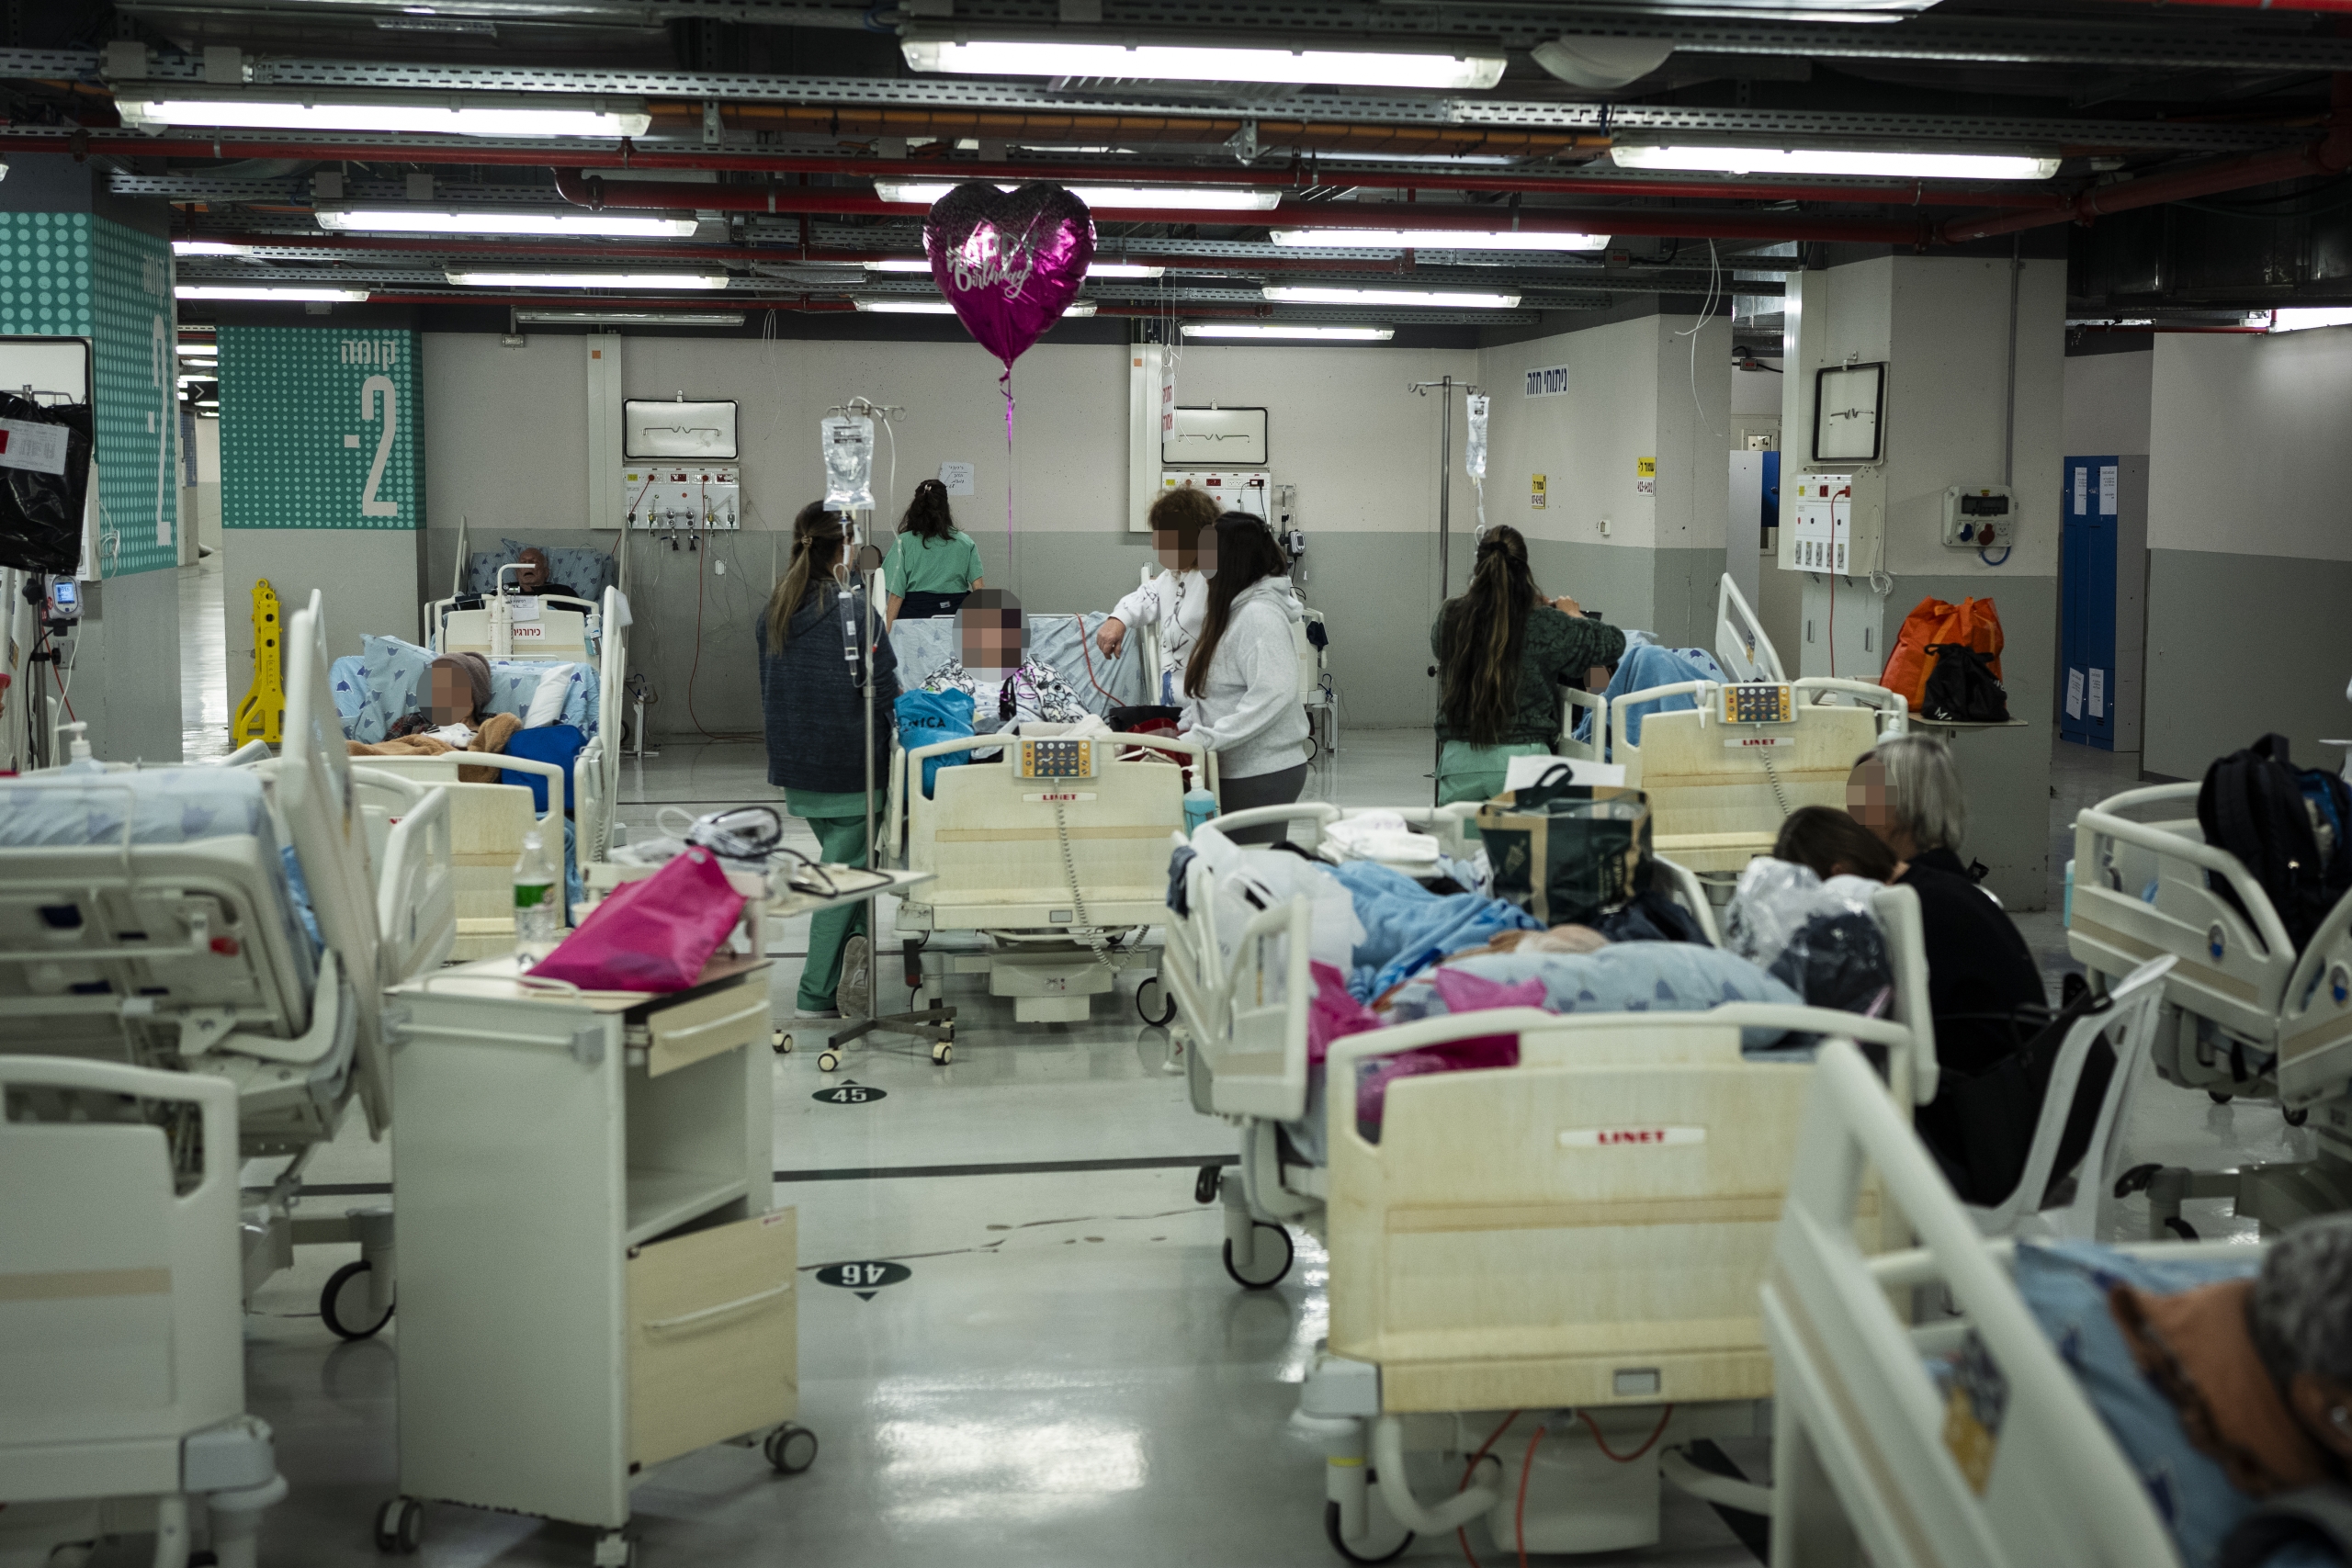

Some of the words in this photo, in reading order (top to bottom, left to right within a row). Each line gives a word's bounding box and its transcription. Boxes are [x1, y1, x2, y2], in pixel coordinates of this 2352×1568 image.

[341, 341, 396, 371] קומה
[1526, 371, 1542, 396] חזה
[1544, 367, 1567, 393] ניתוחי
[344, 375, 398, 517] -2
[1742, 738, 1776, 746] LINET
[831, 1089, 867, 1102] 45
[1597, 1130, 1666, 1145] LINET
[841, 1263, 887, 1285] 46
